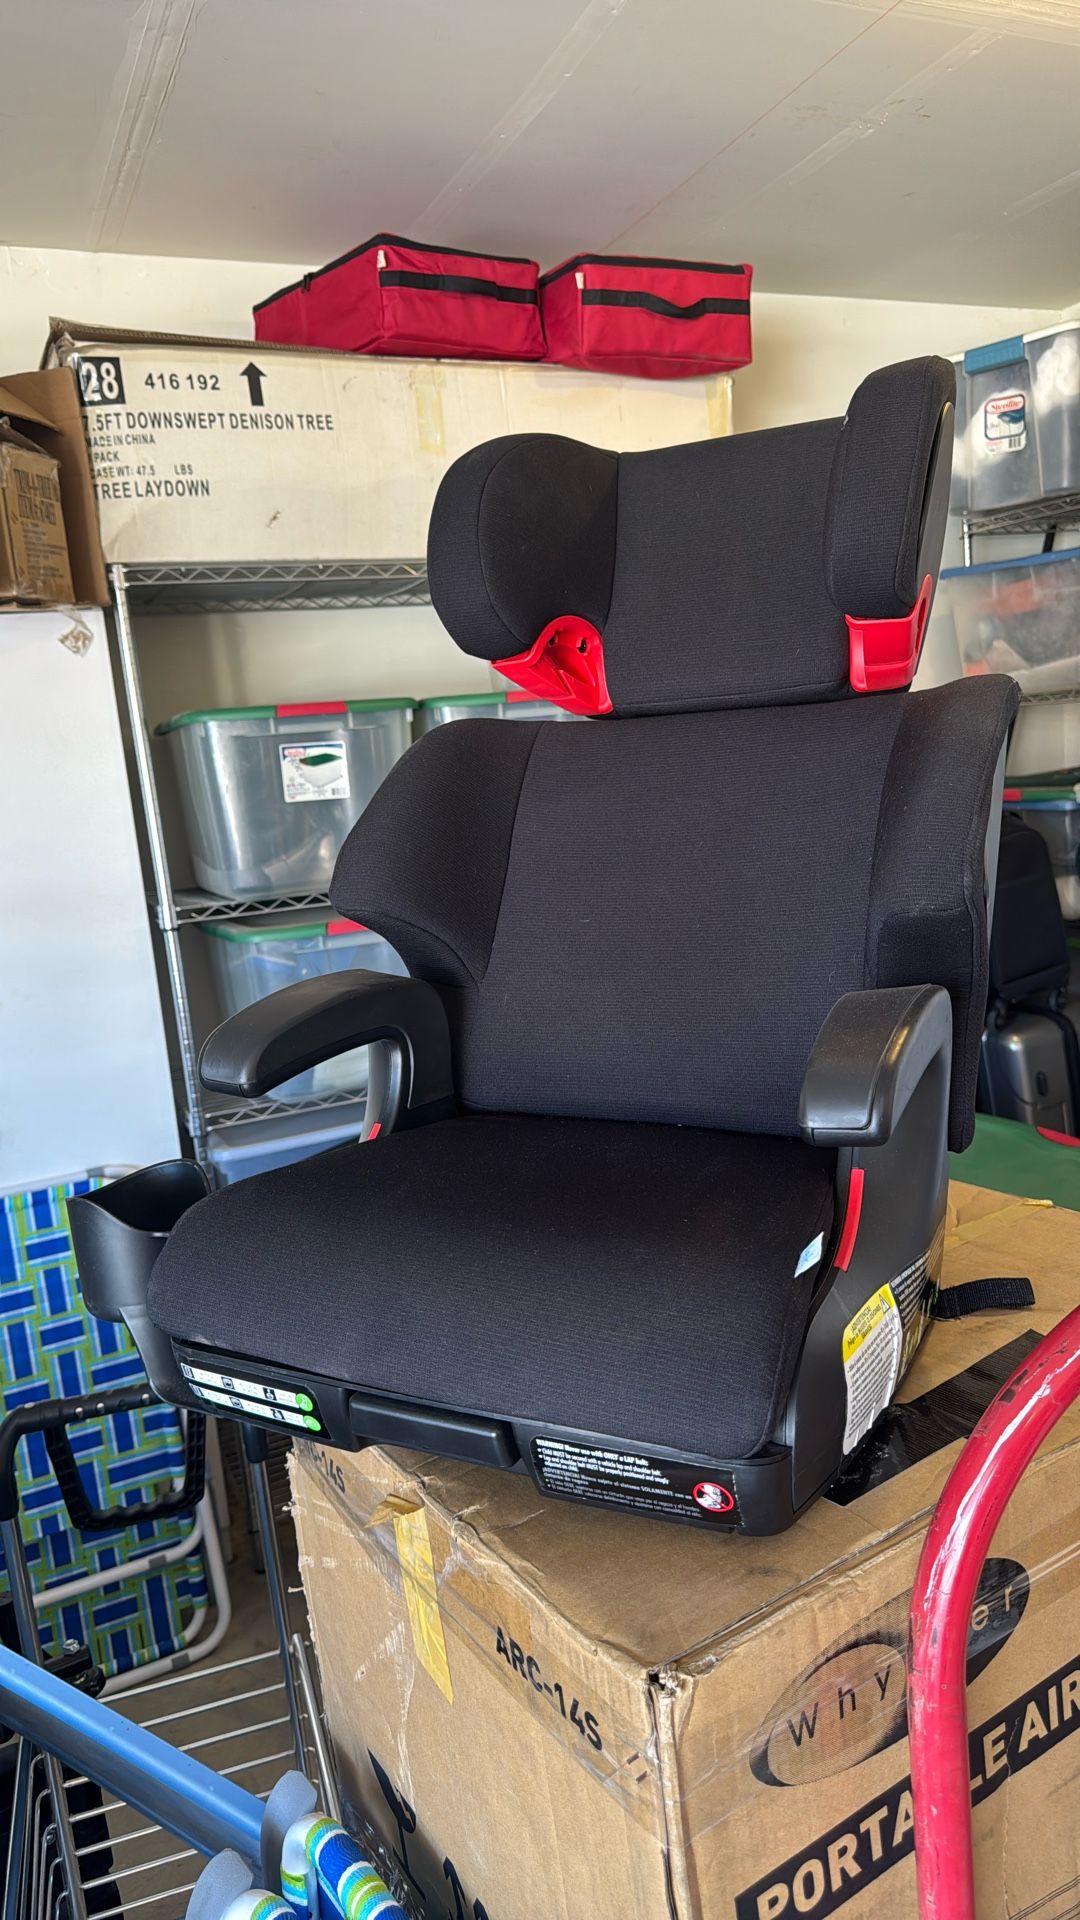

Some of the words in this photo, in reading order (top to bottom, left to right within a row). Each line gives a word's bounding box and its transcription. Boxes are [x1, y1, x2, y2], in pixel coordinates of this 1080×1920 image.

[80, 361, 120, 402] 28
[144, 372, 180, 390] 416
[186, 374, 221, 391] 192
[126, 411, 226, 430] DOWNSWEPT
[228, 413, 295, 430] DENISON
[297, 414, 335, 431] TREE
[113, 434, 124, 446] IN
[125, 433, 156, 446] CHINA
[94, 451, 121, 463] PACK
[117, 465, 134, 477] WT:
[136, 464, 156, 476] 47.5
[174, 463, 194, 476] LBS
[93, 482, 132, 500] TREE
[135, 479, 210, 498] LAYDOWN
[536, 1439, 564, 1450] WARNING!
[564, 1444, 580, 1453] Never
[590, 1450, 604, 1458] with
[603, 1452, 619, 1460] ONLY
[624, 1455, 635, 1464] LAP
[496, 1625, 602, 1750] ARC-14S
[756, 1721, 1008, 1920] PORTAE
